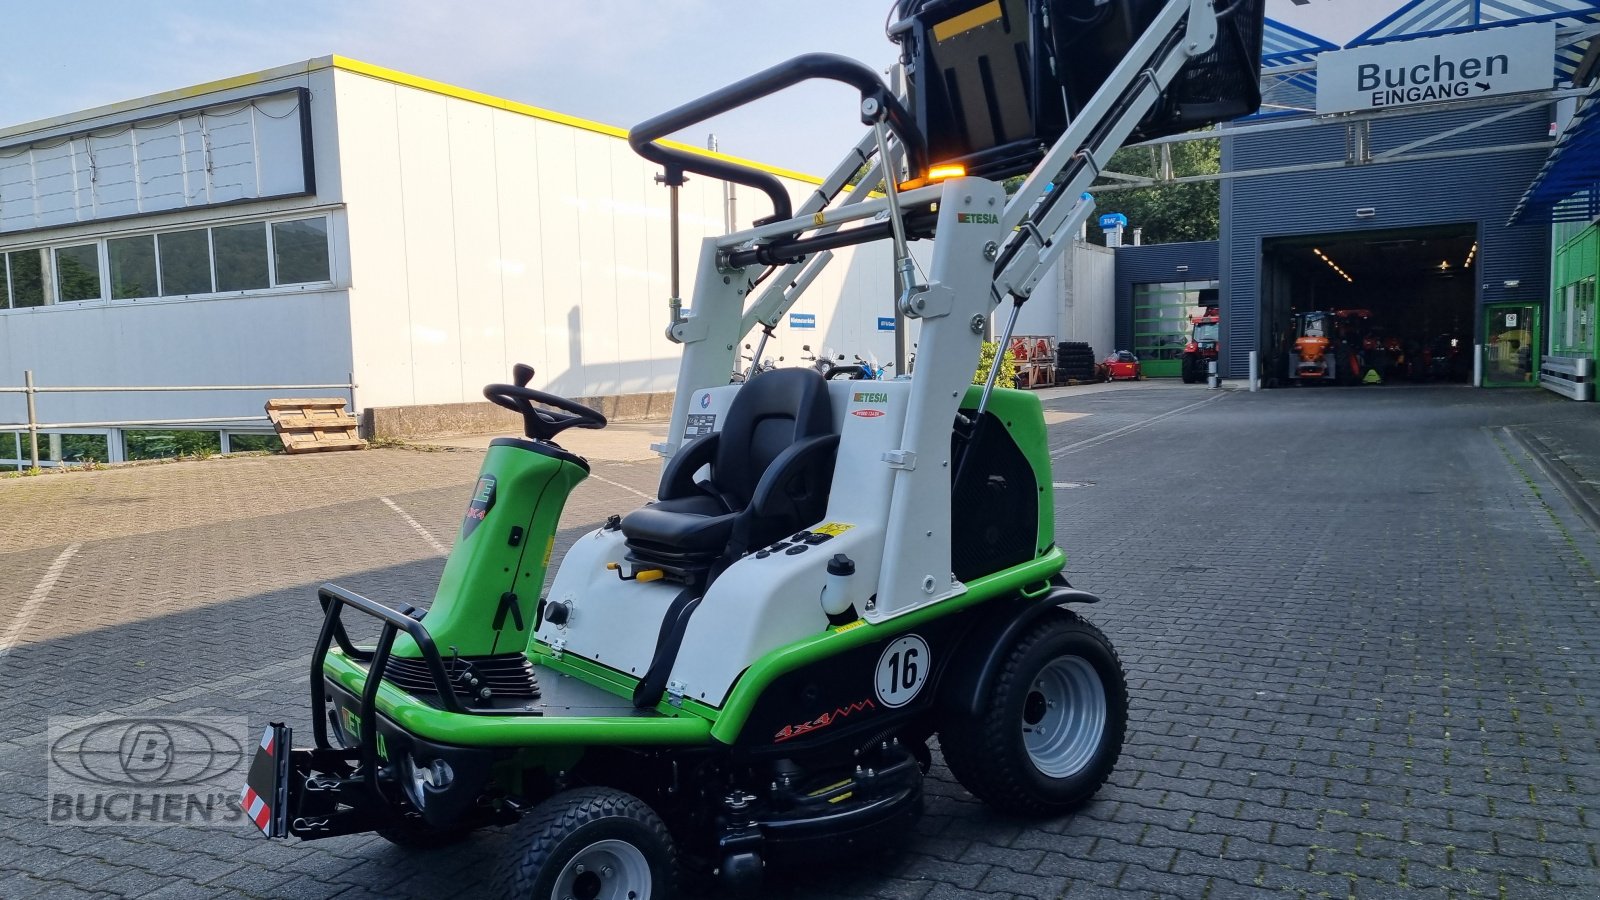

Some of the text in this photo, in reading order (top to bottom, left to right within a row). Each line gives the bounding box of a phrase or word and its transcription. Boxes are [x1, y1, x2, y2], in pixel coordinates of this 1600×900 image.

[1358, 54, 1509, 92] Buchen
[1372, 81, 1469, 107] EINGANG
[957, 212, 999, 225] ETESIA
[853, 392, 888, 403] ETESIA
[888, 648, 919, 694] 16
